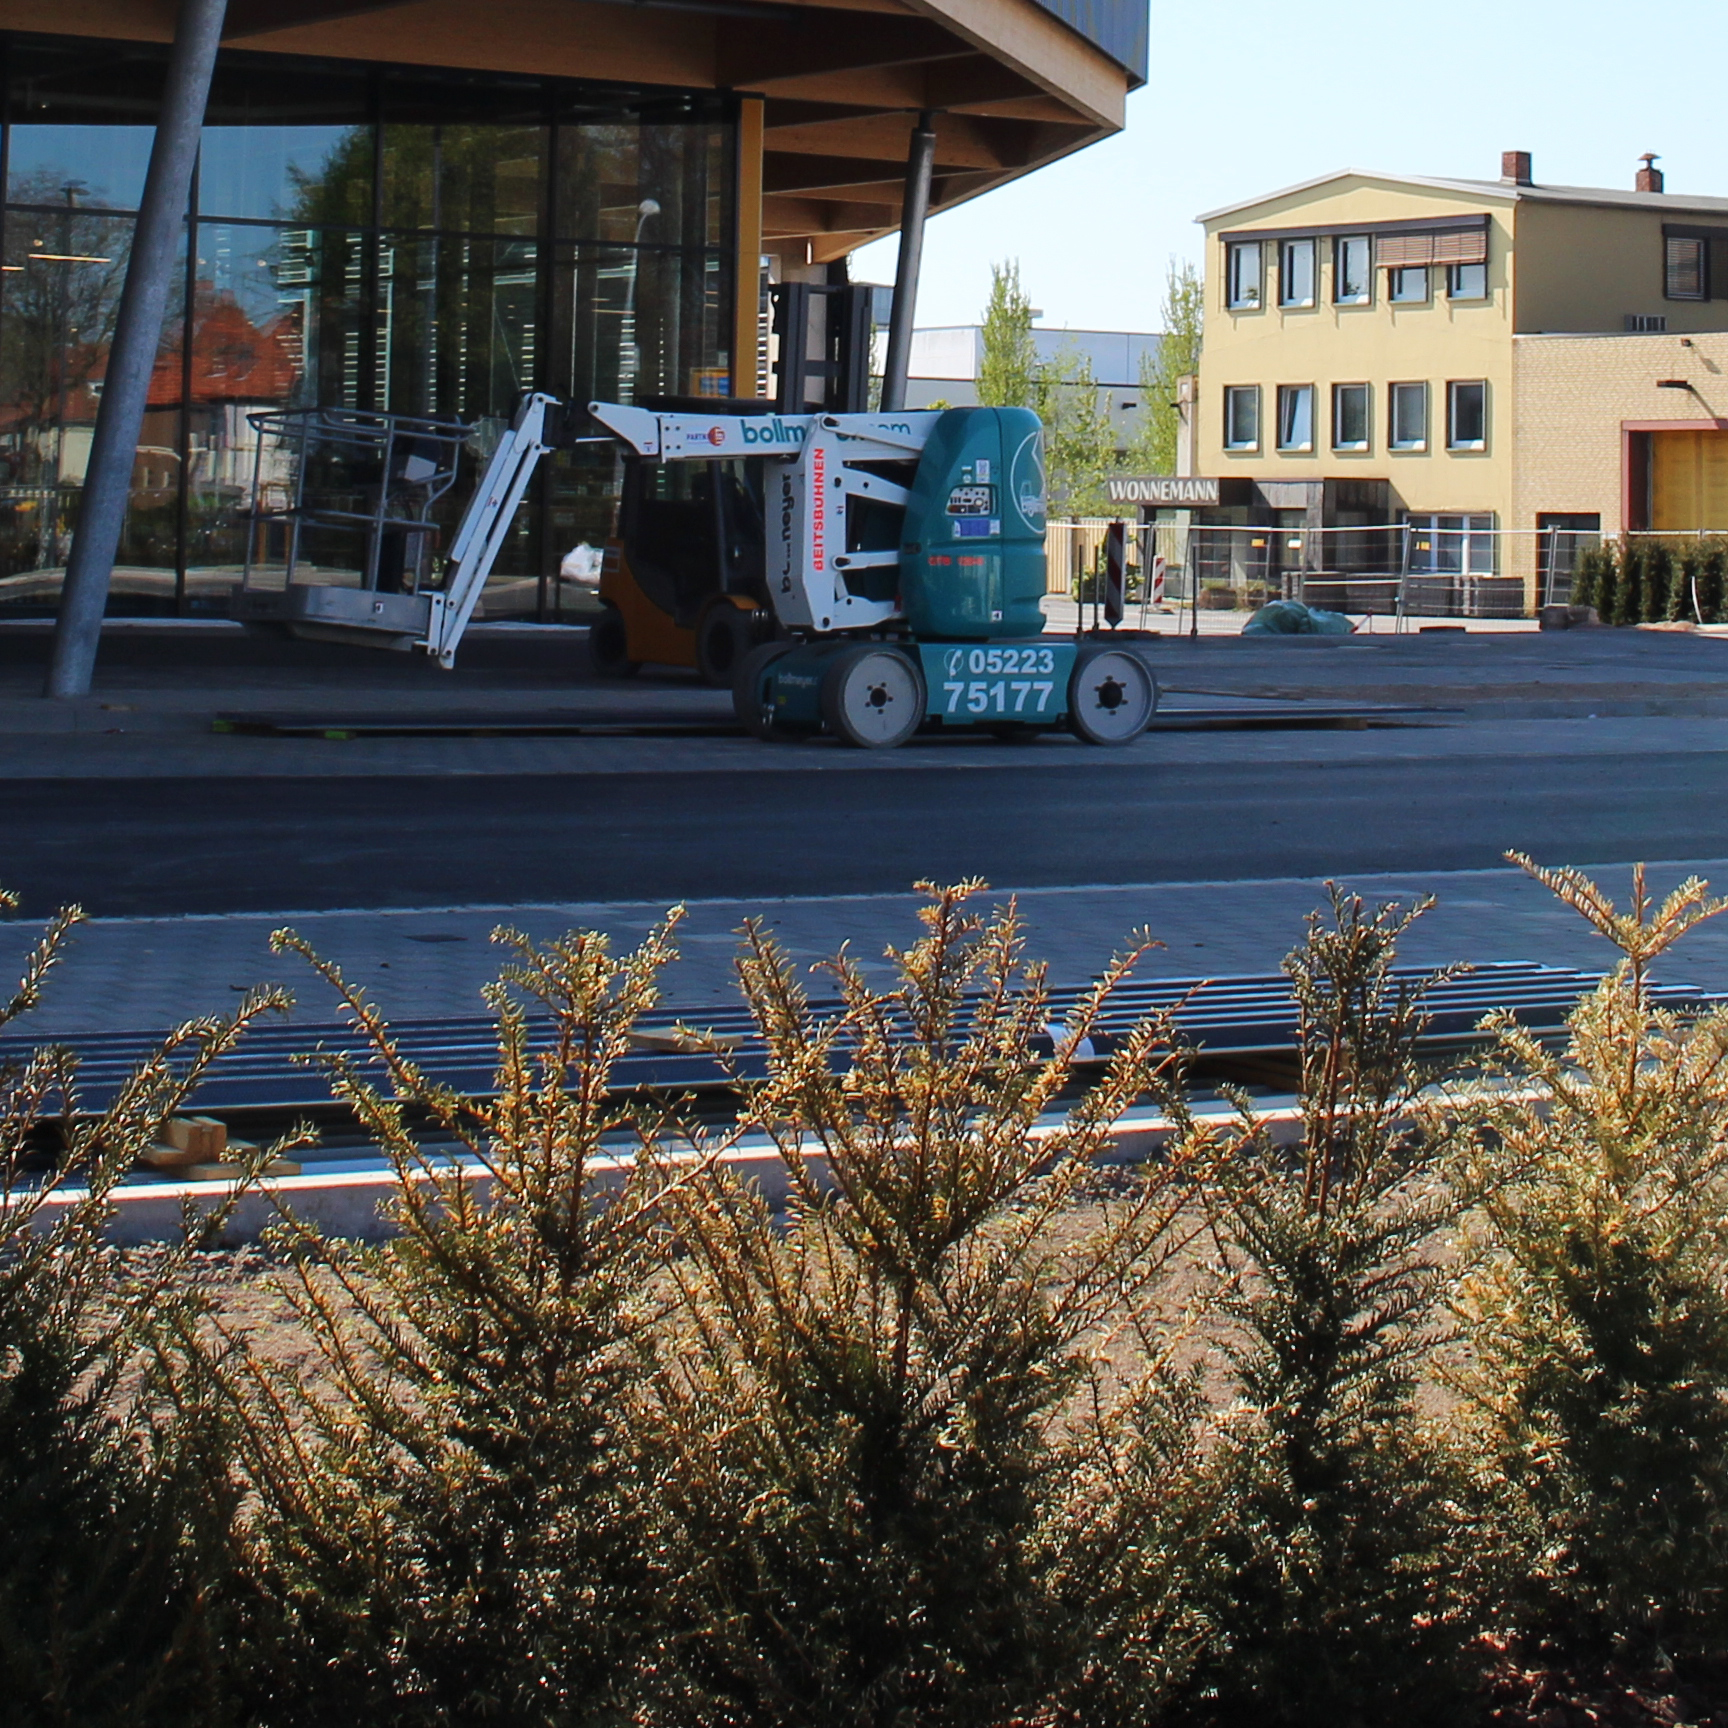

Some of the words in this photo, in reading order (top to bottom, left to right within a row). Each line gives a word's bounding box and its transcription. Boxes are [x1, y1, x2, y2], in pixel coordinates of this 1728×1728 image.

[1109, 480, 1218, 502] WONNEMANN
[968, 648, 1055, 674] 05223
[943, 680, 1054, 713] 75177
